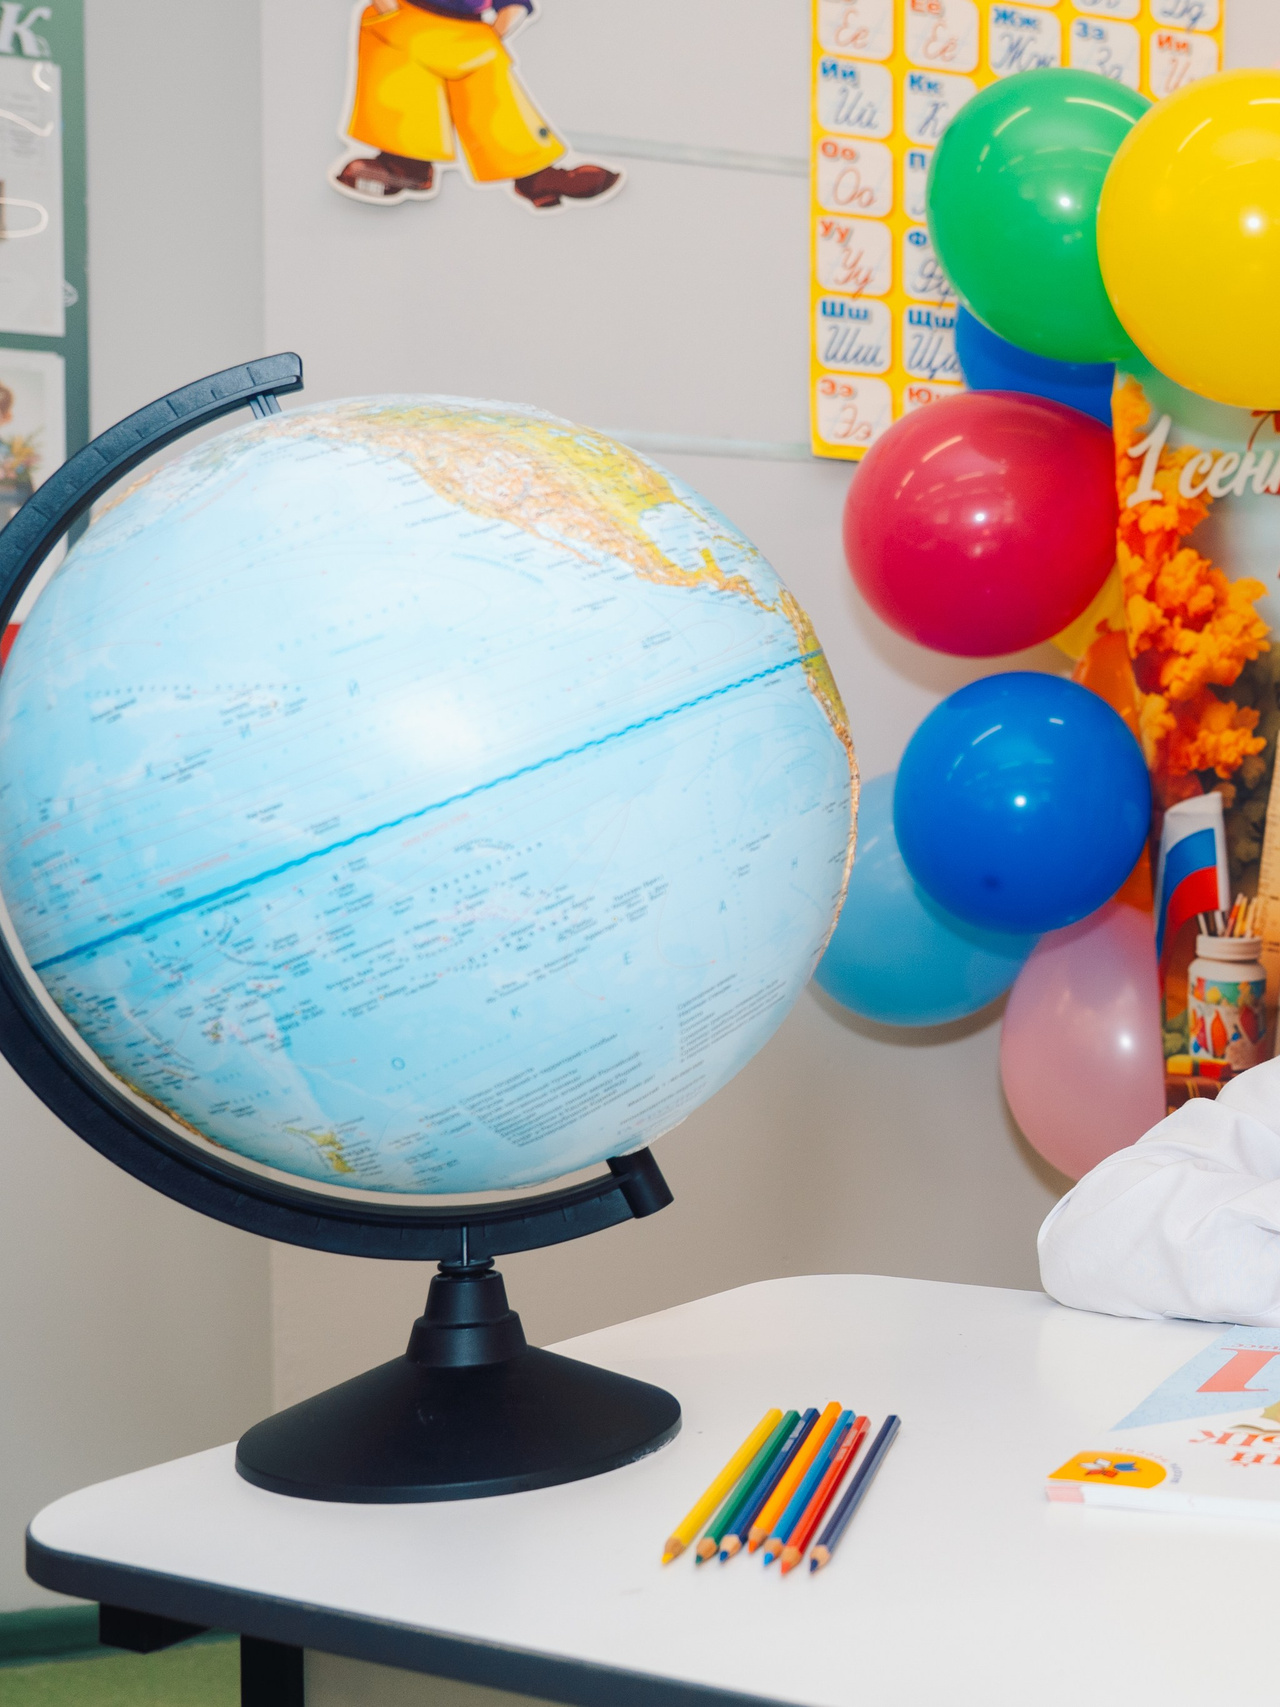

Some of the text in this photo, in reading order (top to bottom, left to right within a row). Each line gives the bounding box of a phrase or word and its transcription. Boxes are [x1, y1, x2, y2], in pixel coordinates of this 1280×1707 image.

[993, 6, 1038, 30] Жж
[1076, 20, 1106, 41] Зз
[1157, 34, 1189, 53] Ии
[909, 73, 942, 93] Кк
[821, 141, 857, 161] Оо
[833, 166, 875, 208] Оо
[821, 220, 851, 244] Уу
[833, 247, 874, 298] Уу
[821, 300, 870, 321] Шш
[822, 324, 884, 368] Шш
[820, 378, 855, 399] Ээ
[833, 403, 872, 441] Ээ
[1126, 413, 1173, 508] 1
